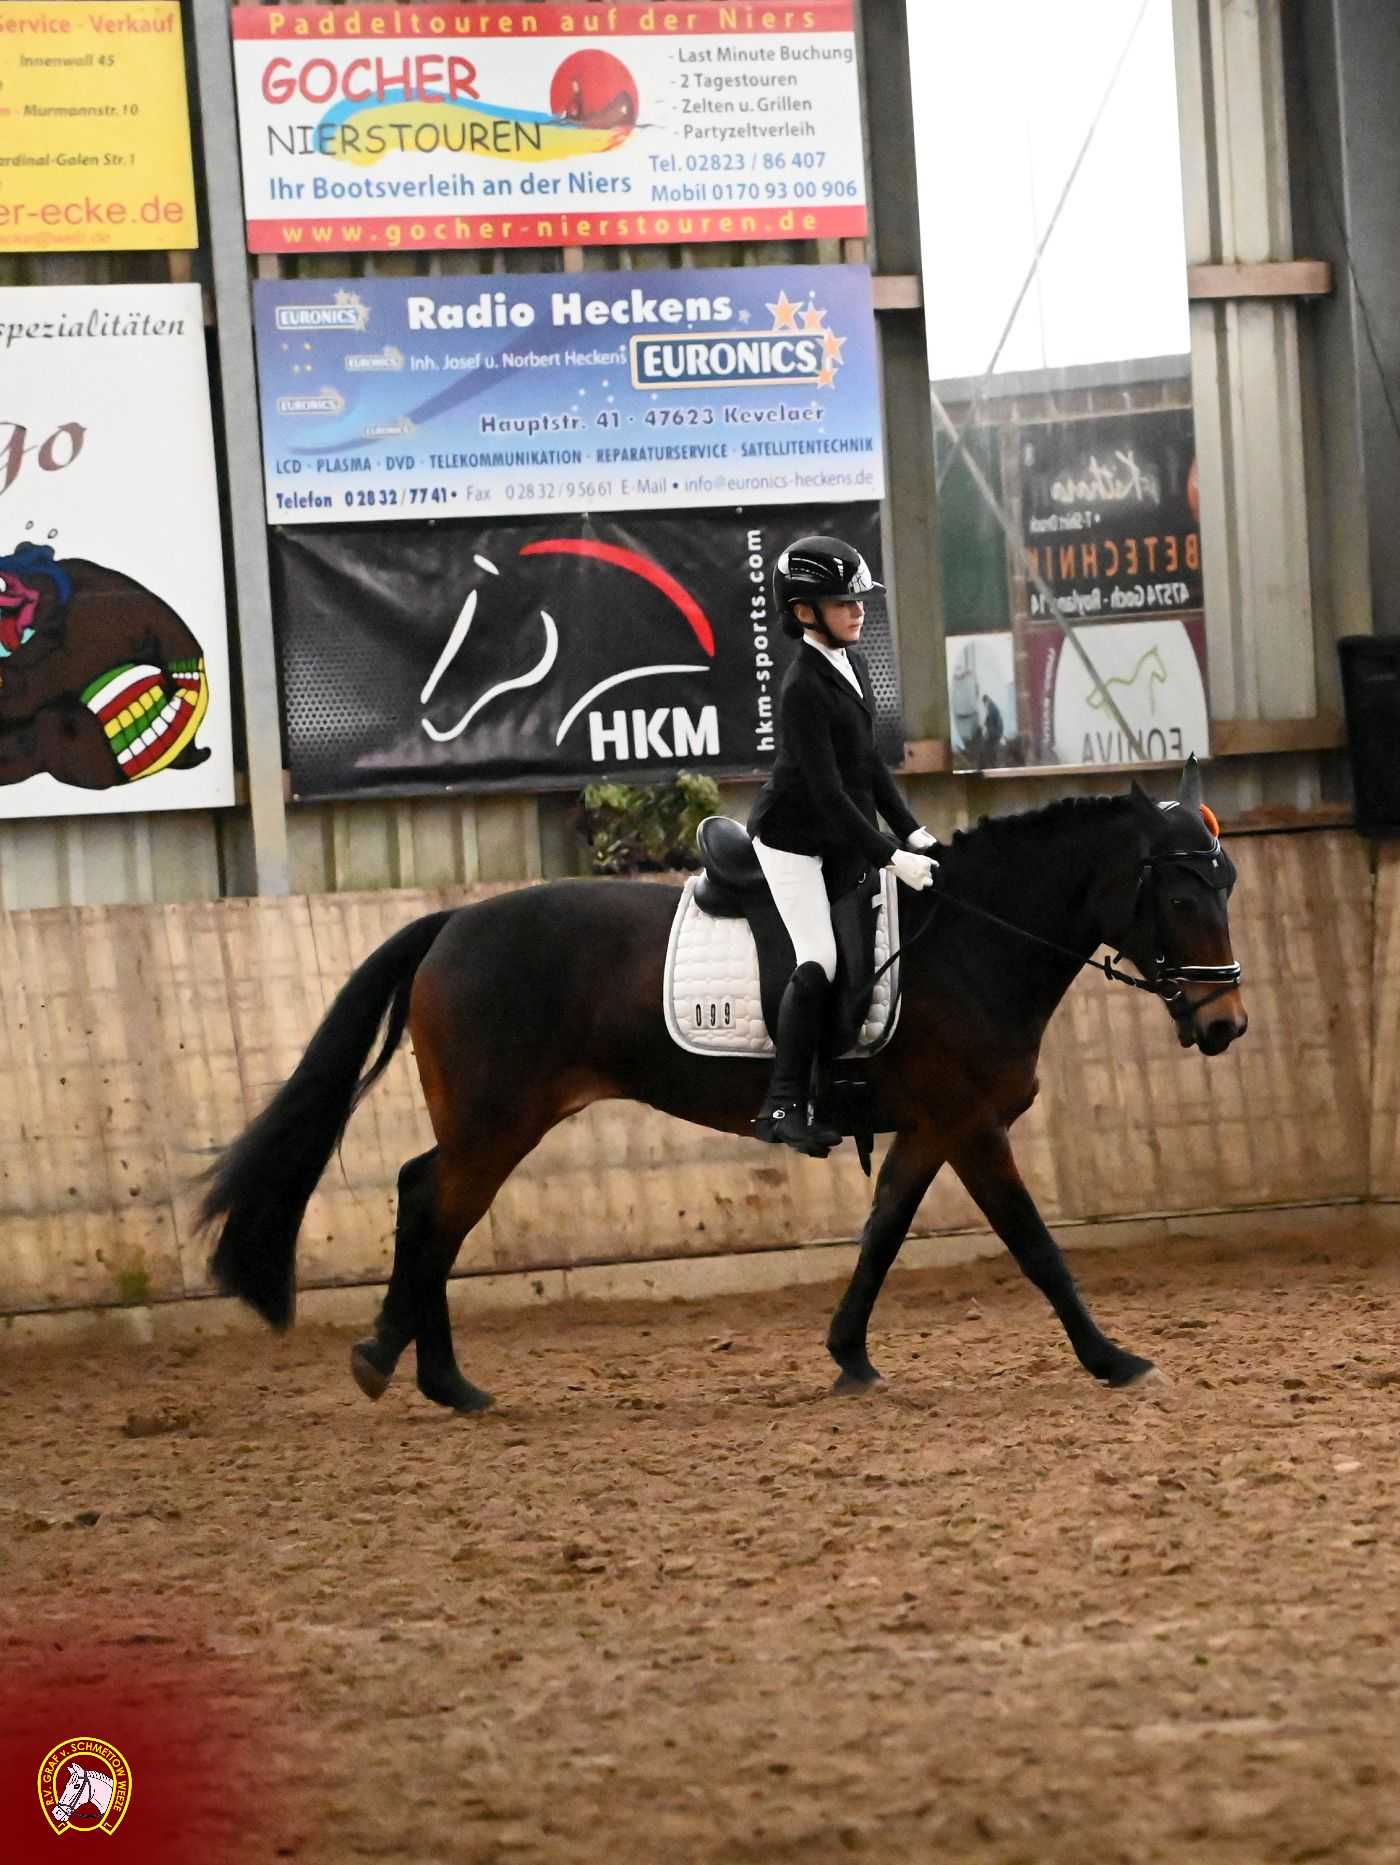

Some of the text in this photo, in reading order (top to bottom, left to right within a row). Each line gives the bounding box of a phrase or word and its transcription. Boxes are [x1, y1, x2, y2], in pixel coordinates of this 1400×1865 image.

[88, 13, 174, 33] Verkauf
[268, 7, 816, 35] Paddeltouren auf der Niers
[19, 54, 115, 67] Innenwall 45
[678, 45, 854, 63] Last Minute Buchung
[261, 54, 480, 105] GOCHER
[680, 72, 798, 92] 2 Tagestouren
[122, 103, 139, 115] 10
[681, 97, 813, 114] Zelten u. Grillen
[266, 120, 543, 157] NIERSTOUREN
[683, 121, 816, 142] Partyzeltverleih
[649, 154, 682, 173] Tel.
[686, 153, 746, 172] 02823
[762, 152, 786, 169] 86
[791, 151, 826, 168] 407
[269, 171, 632, 200] Ihr Bootsverleih an der Niers
[650, 180, 857, 203] Mobil 0170 93 00 906
[282, 209, 818, 247] www.gocher-nierstouren.de
[280, 308, 358, 326] EURONICS
[407, 289, 732, 330] Radio Heckens
[410, 350, 627, 371] Inh. Josef u. Norbert Heckens
[643, 340, 817, 378] EURONICS
[481, 405, 826, 436] Hauptstr. 41 47623 Kevelaer
[276, 437, 874, 475] LCD PLASMA DVD TELEKOMMUNIKATION REPARATURSERVICE SATELLITENTECHNIK
[276, 491, 333, 509] Telefon
[466, 484, 491, 501] Fax
[621, 475, 667, 495] E-Mail
[746, 529, 776, 752] hkm-sports.com
[589, 704, 720, 762] HKM
[695, 1001, 731, 1027] 099
